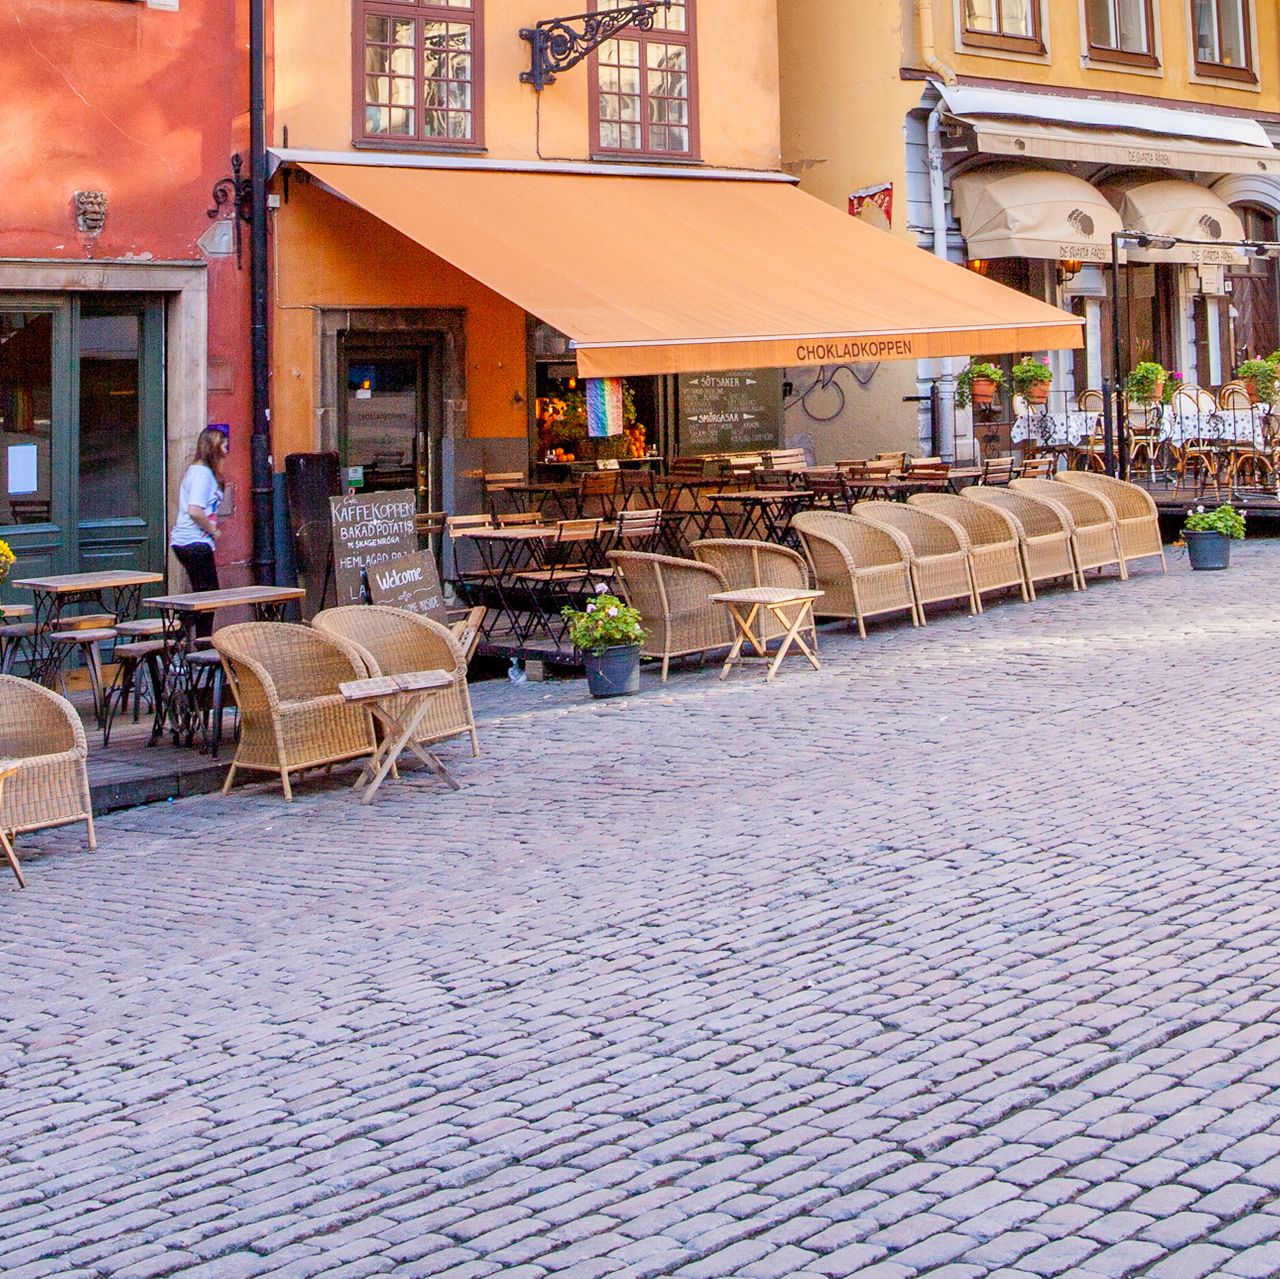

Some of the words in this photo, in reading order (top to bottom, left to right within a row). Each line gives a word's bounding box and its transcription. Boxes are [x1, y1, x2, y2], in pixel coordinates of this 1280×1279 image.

[796, 340, 912, 361] CHOKLADKOPPEN
[700, 375, 740, 388] SÖTSAKER
[331, 502, 416, 526] KAFFEKOPPEN
[340, 524, 375, 540] BAKAD
[376, 521, 414, 535] POTATIS
[340, 552, 389, 569] HEMLAGAD
[376, 567, 423, 590] Welcome
